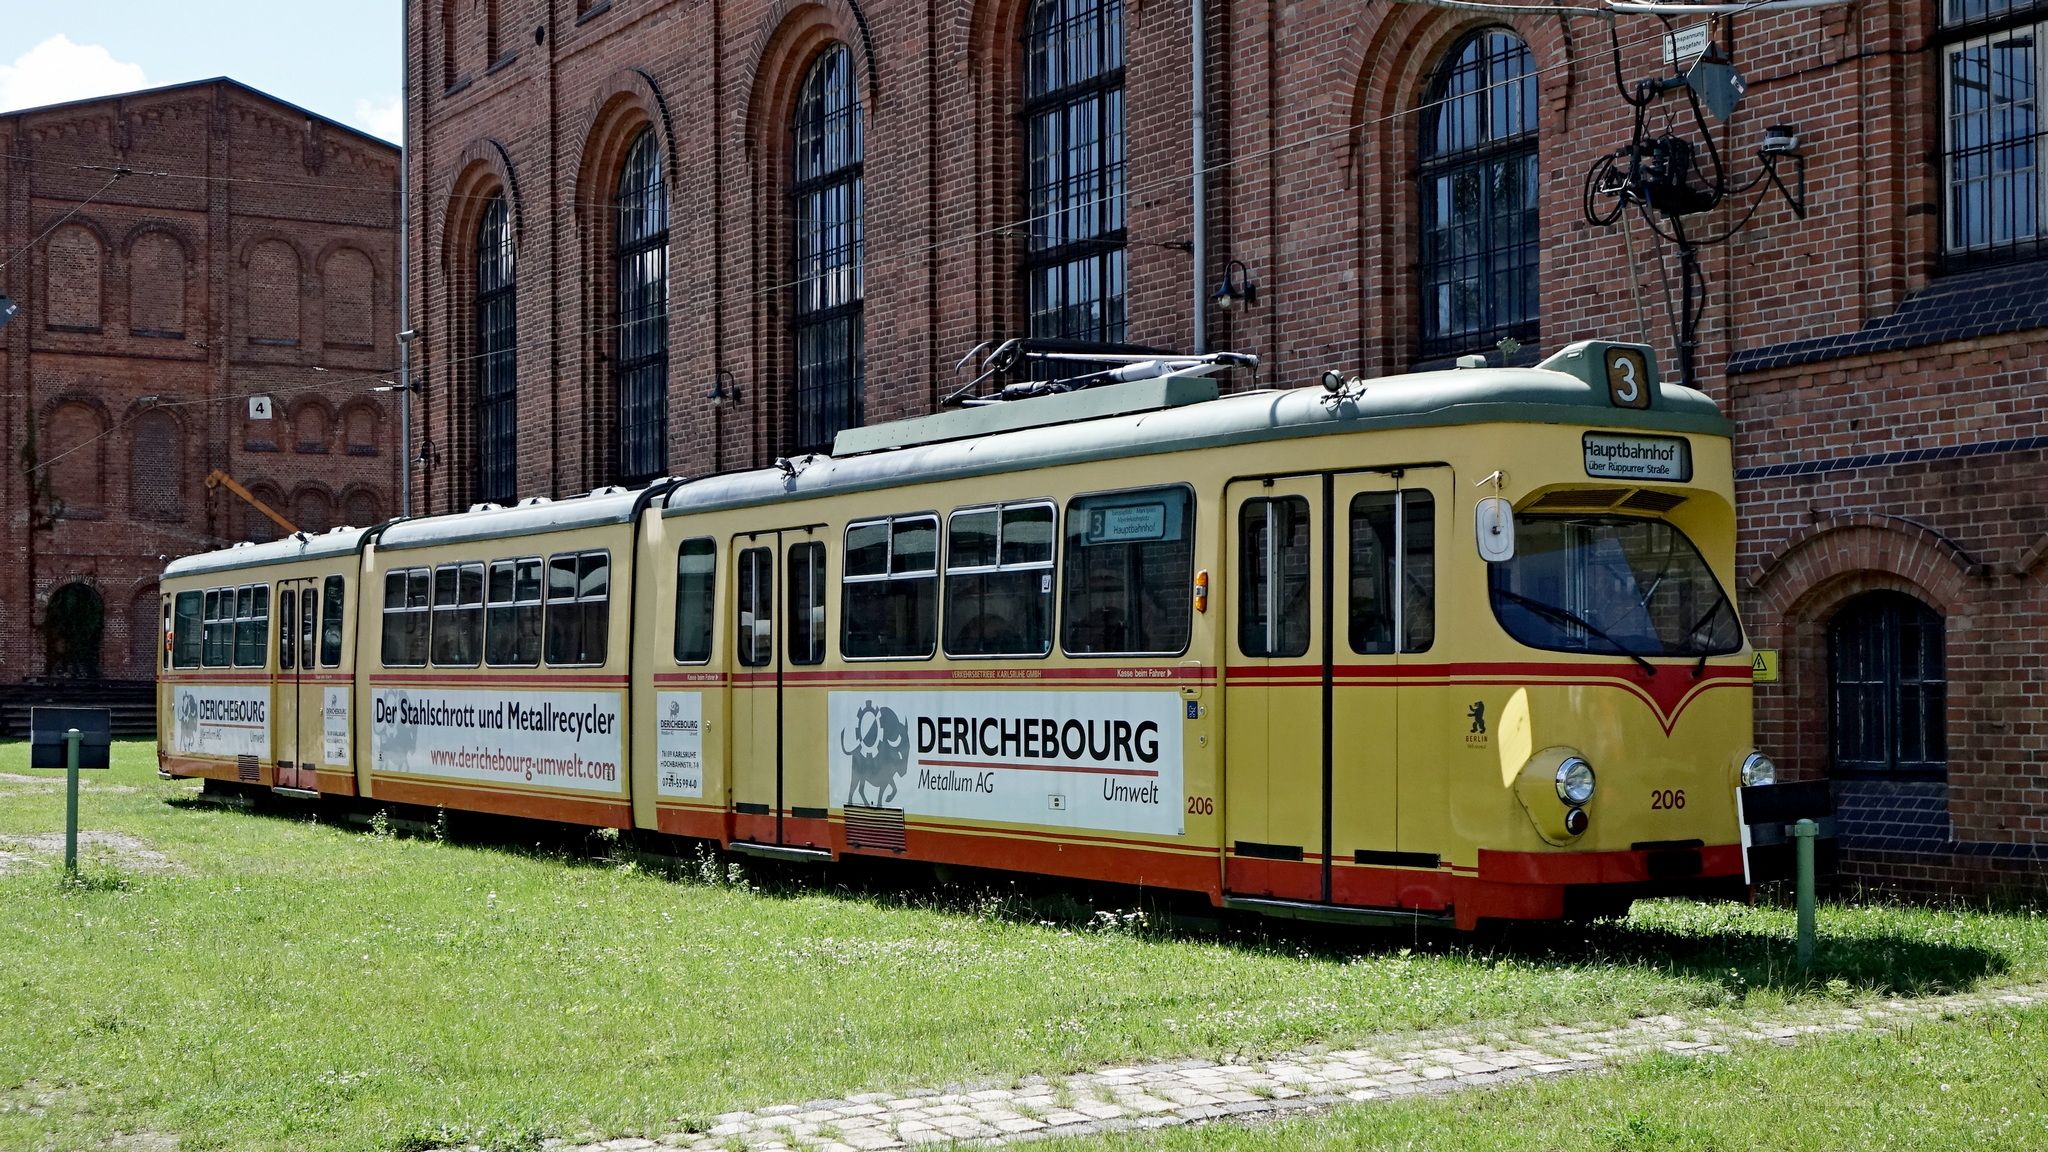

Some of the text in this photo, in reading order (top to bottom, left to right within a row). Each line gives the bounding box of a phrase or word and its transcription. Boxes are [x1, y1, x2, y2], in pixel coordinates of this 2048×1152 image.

[1667, 30, 1705, 46] Hhspannung
[1667, 40, 1702, 55] Leensgefahr
[1614, 357, 1638, 402] 3
[256, 402, 265, 414] 4
[1584, 440, 1675, 461] Hauptbahnhof
[1588, 461, 1670, 475] über Rüppurrer Straße
[1093, 513, 1103, 535] 3
[1113, 522, 1156, 536] Hauptbahnhof
[997, 670, 1026, 678] KARLSRUHE
[1116, 668, 1166, 678] Kasse beim Fahrer
[200, 699, 265, 722] DERICHEBOURG
[376, 698, 615, 742] Der Stahlschrott und Metallrecycler
[660, 720, 698, 729] DERICHEBOURG
[917, 716, 1159, 763] DERICHEBOURG
[1465, 735, 1488, 743] BERLIN
[430, 745, 616, 781] www.derichebourg-umwelt.com
[672, 750, 697, 759] KARLSRUHE
[918, 769, 1159, 804] Metallum AG Umwelt
[1187, 796, 1214, 815] 206
[1651, 789, 1686, 810] 206
